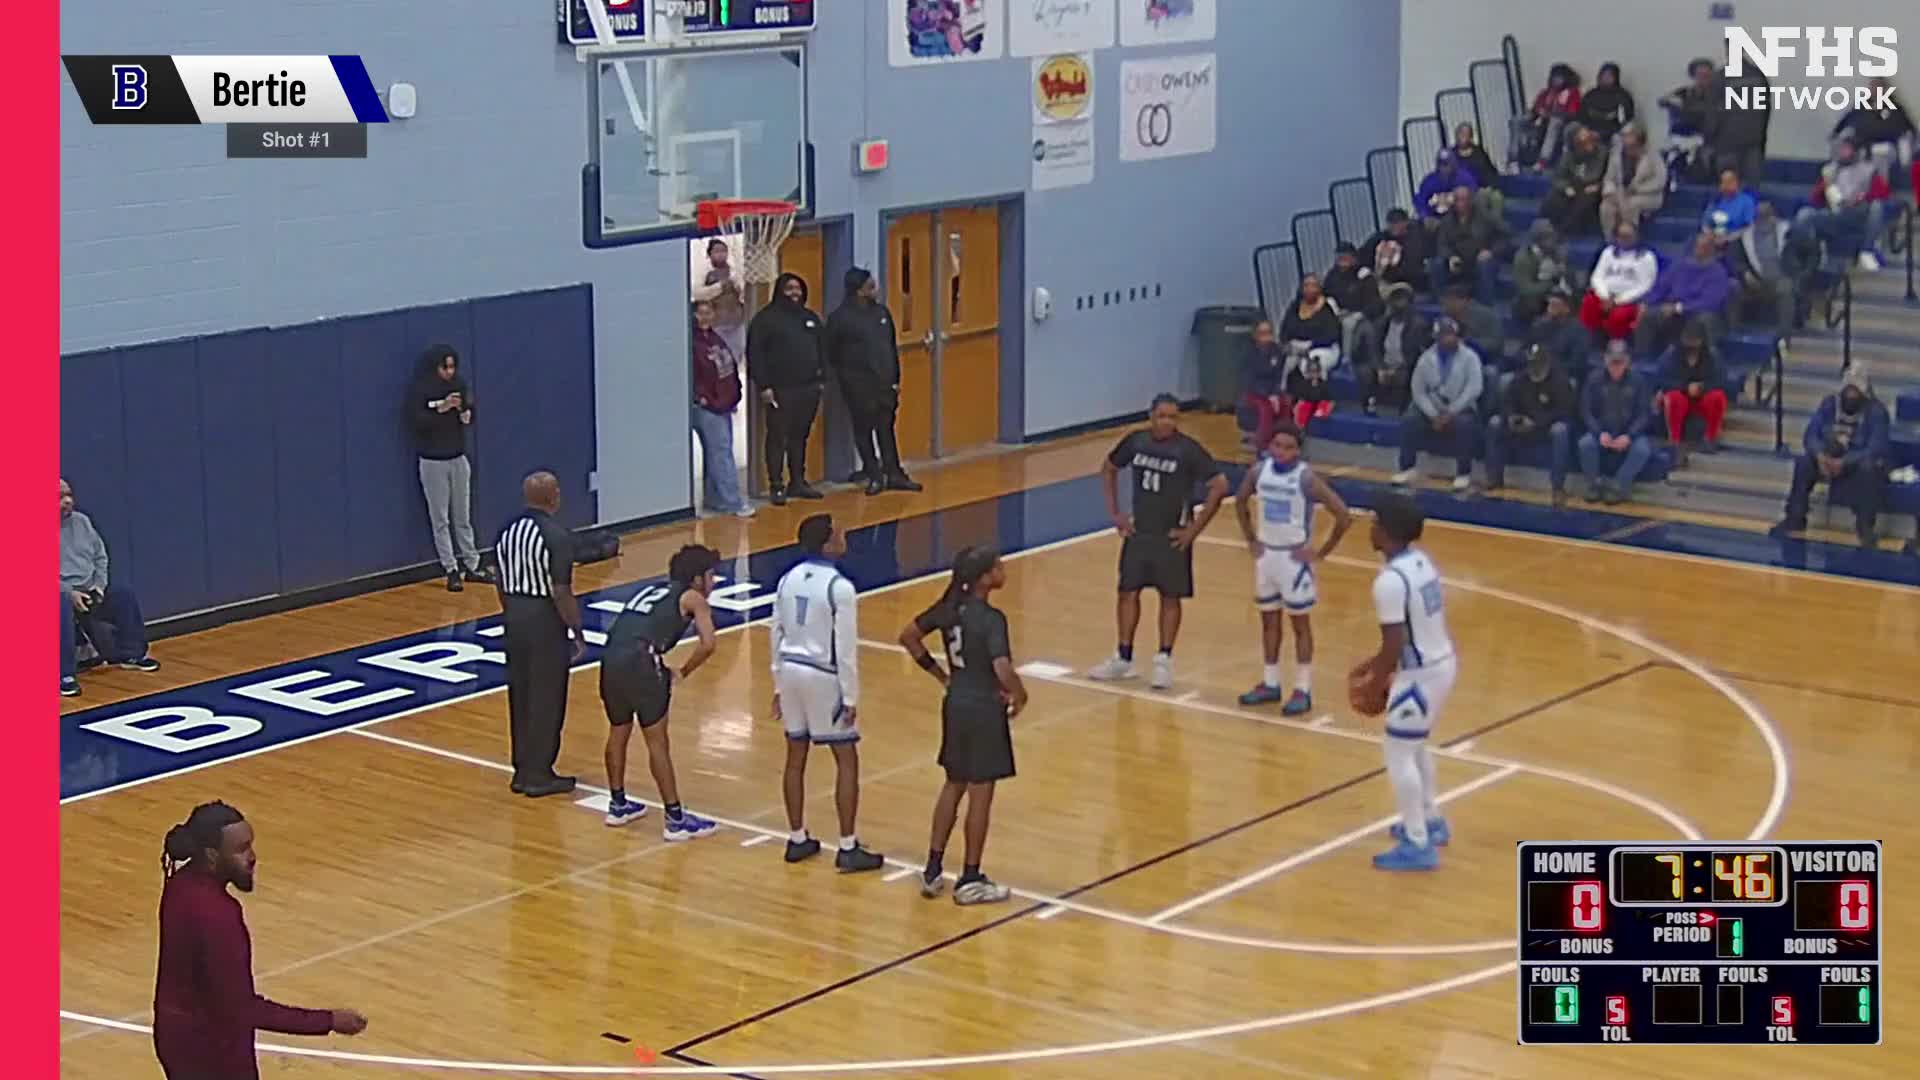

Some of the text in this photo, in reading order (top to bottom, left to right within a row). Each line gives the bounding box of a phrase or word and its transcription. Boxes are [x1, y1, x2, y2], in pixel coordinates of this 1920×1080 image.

[607, 13, 639, 31] ONUS
[754, 6, 790, 24] BONUS
[626, 585, 671, 614] 12
[795, 595, 809, 625] 1
